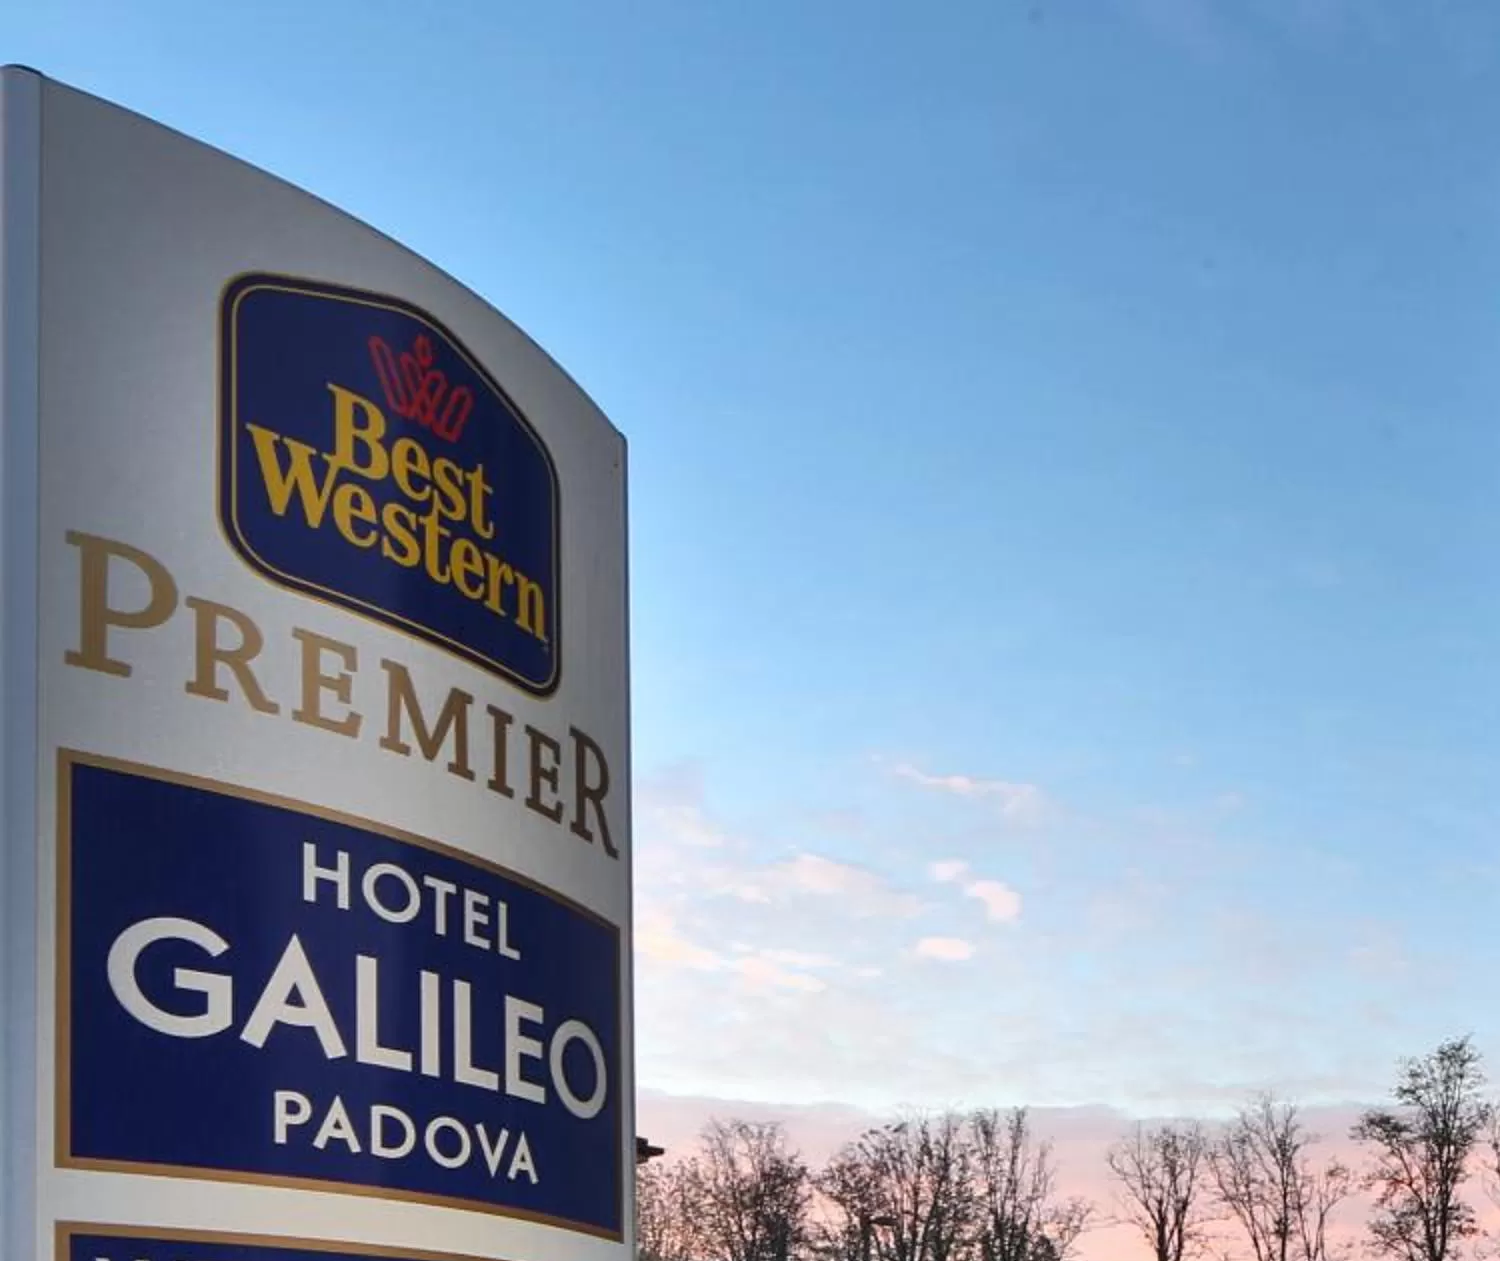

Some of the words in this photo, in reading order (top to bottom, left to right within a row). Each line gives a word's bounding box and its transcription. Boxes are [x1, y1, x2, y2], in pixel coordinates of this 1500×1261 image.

[245, 423, 548, 643] Western
[328, 384, 494, 538] Best
[64, 530, 619, 859] PREMIER
[304, 842, 520, 960] HOTEL
[107, 917, 607, 1119] GALILEO
[274, 1090, 539, 1185] PADOVA
